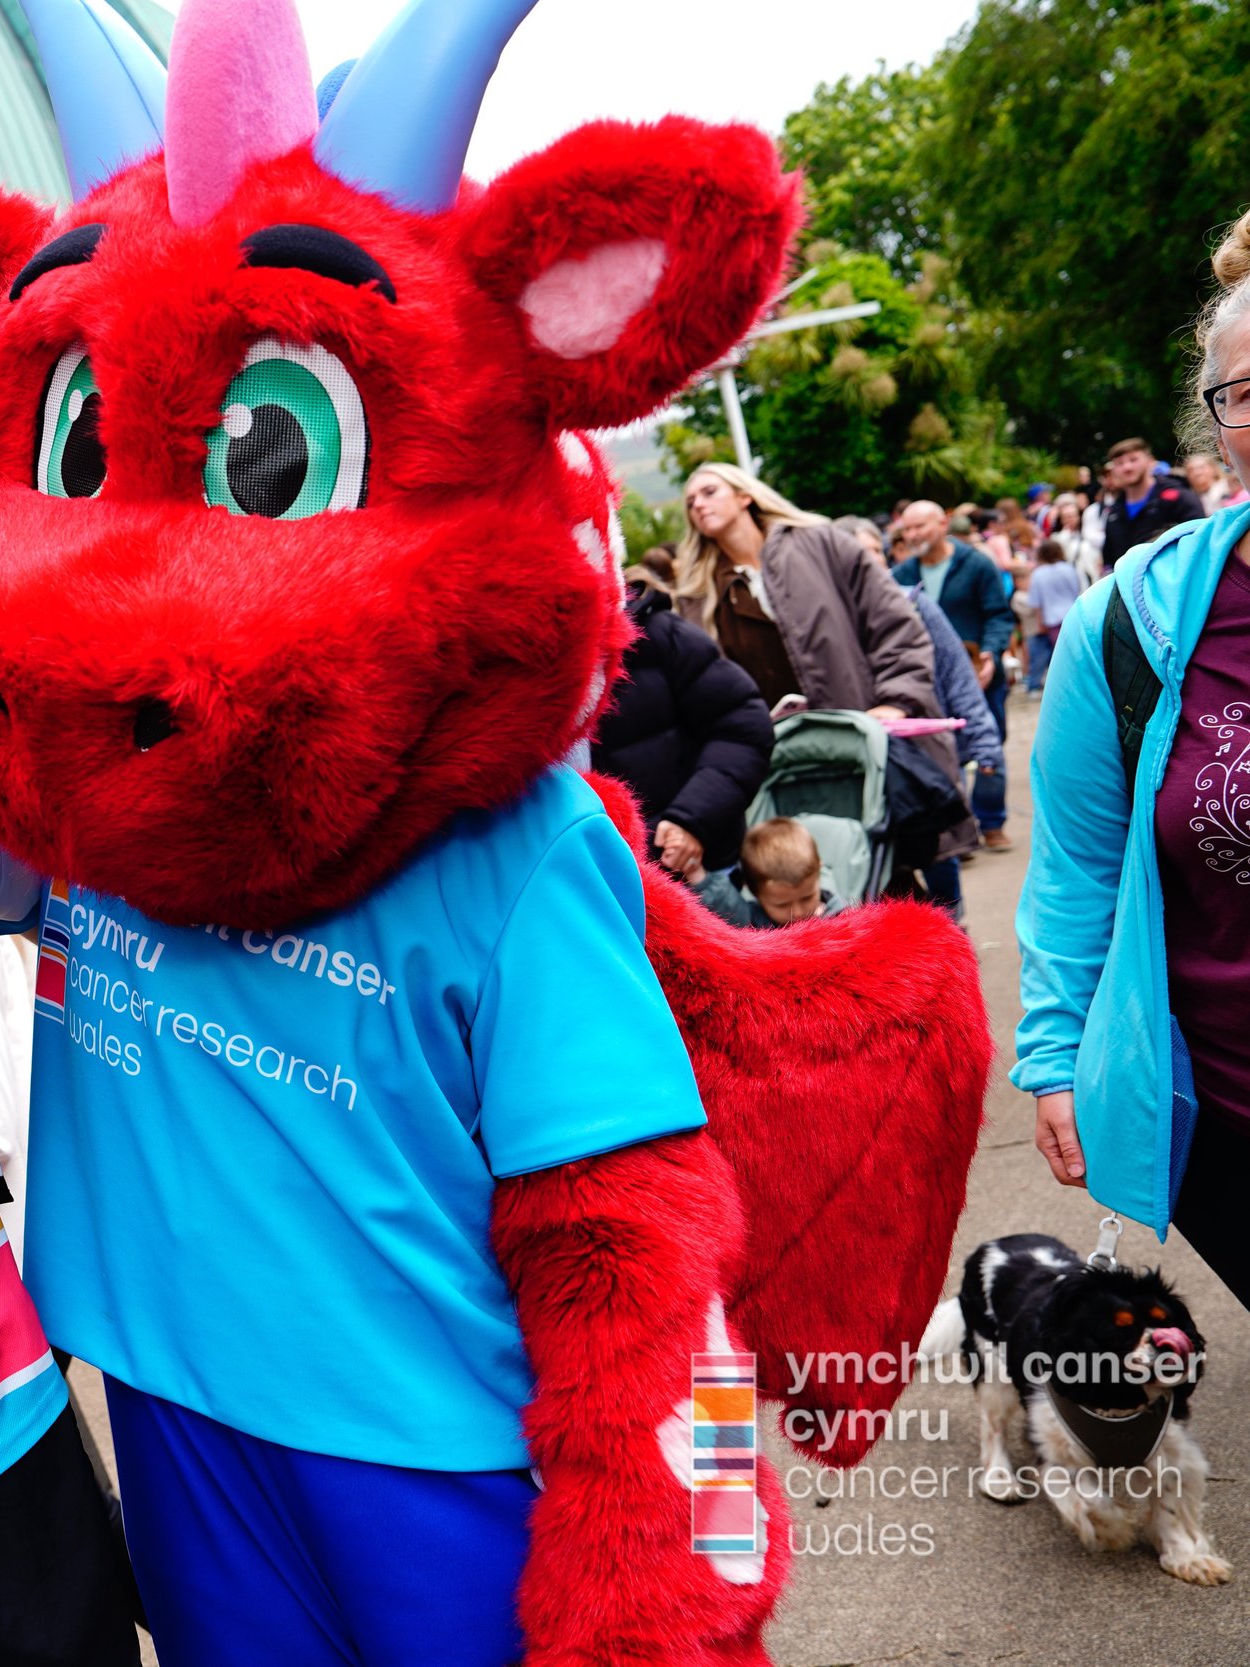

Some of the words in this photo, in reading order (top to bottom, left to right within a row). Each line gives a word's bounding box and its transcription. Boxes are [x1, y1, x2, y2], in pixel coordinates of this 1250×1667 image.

[70, 903, 166, 973] cymru
[241, 929, 397, 1006] canser
[68, 1009, 143, 1076] wales
[69, 956, 154, 1028] cancer
[155, 1003, 358, 1111] research
